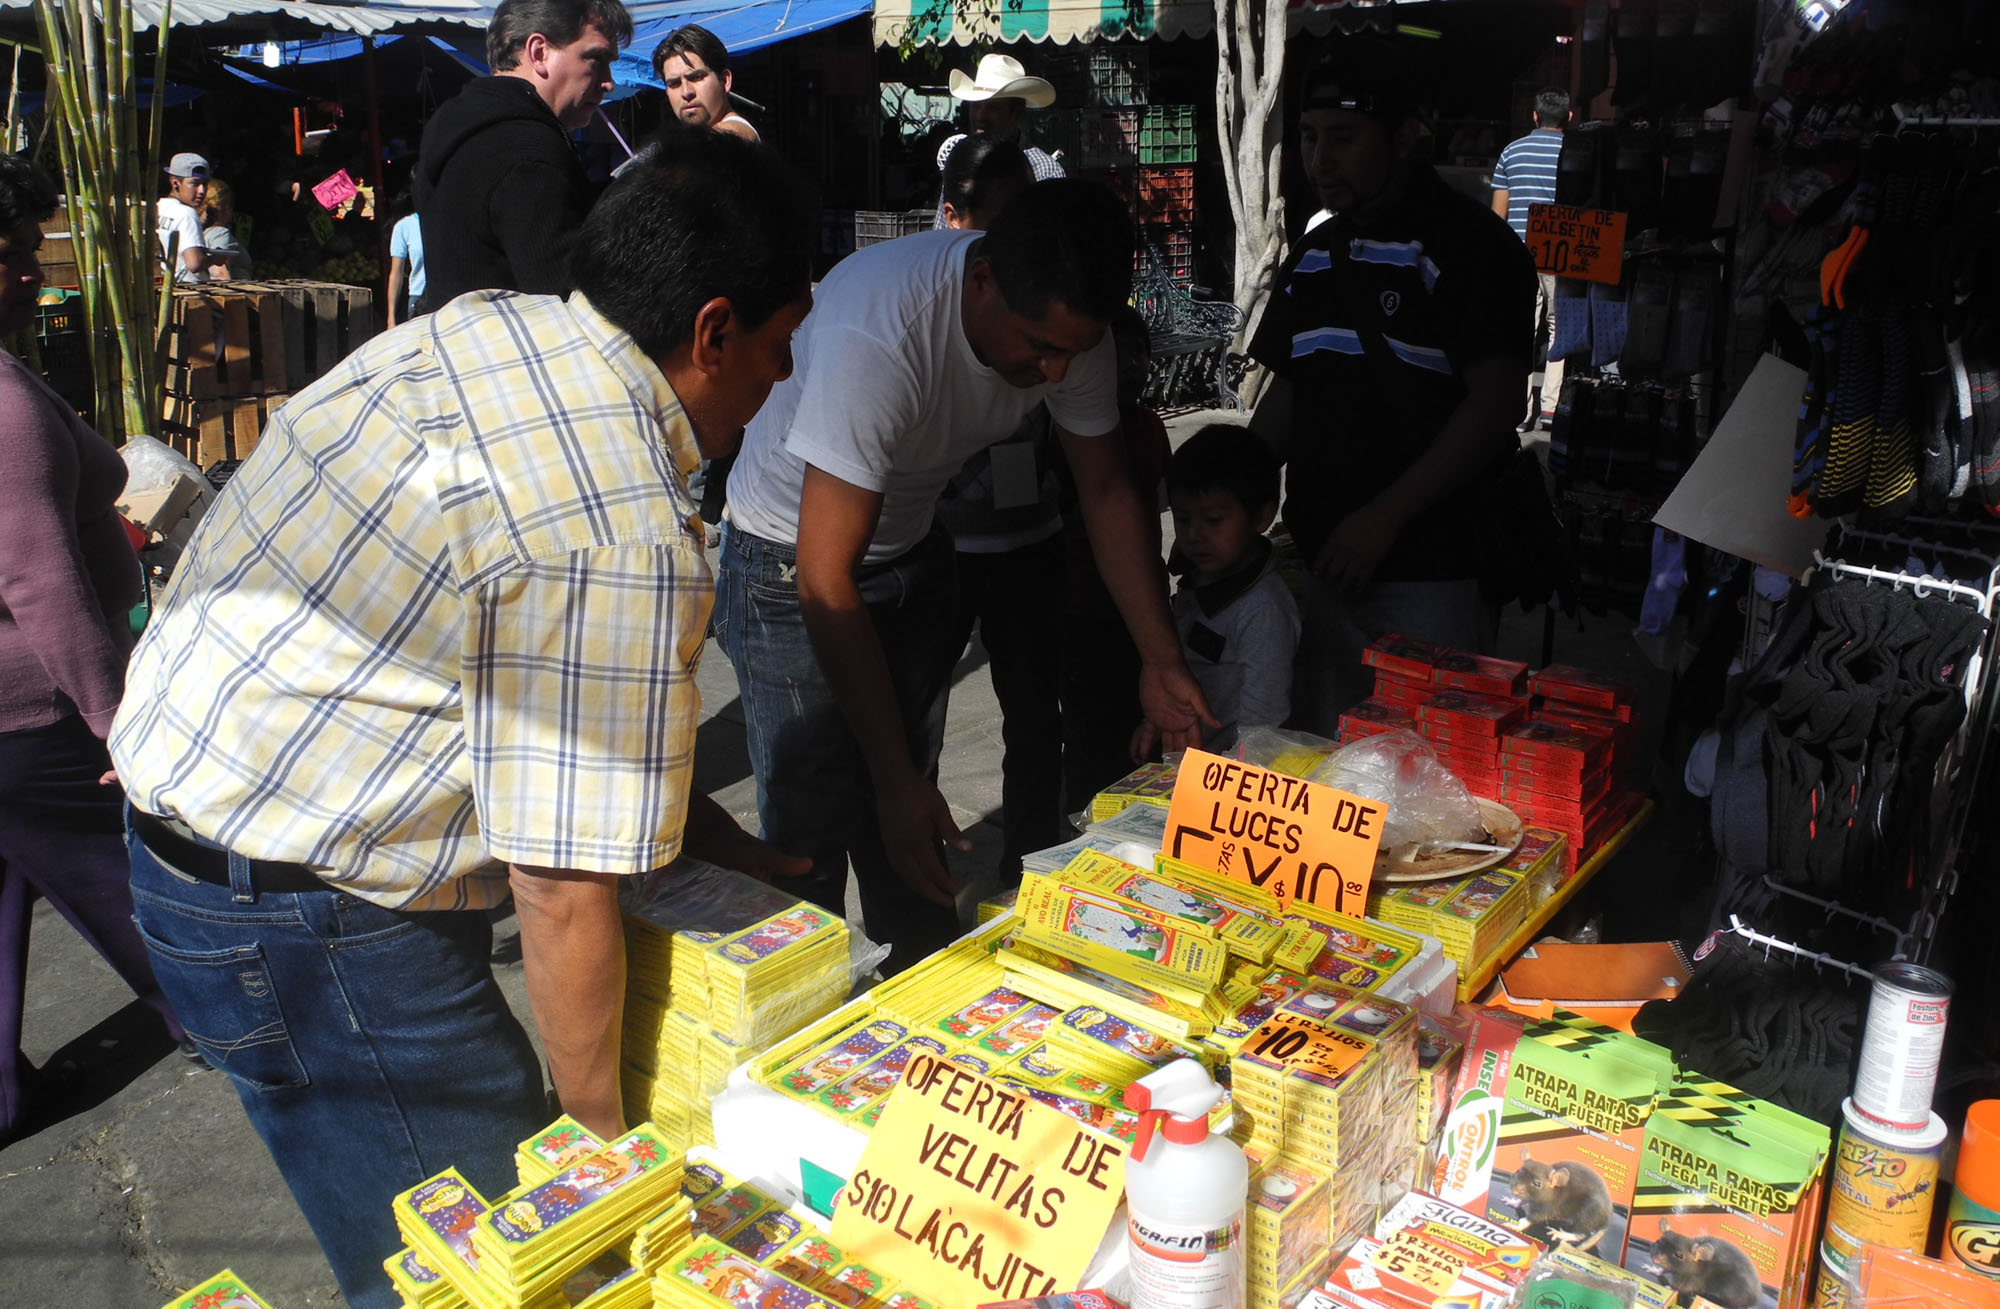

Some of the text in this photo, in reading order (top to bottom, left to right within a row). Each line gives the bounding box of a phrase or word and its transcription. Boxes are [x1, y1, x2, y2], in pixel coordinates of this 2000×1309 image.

[1529, 203, 1615, 226] OFERTA DE
[1532, 219, 1600, 240] CALSETIN
[1203, 762, 1377, 840] OFERTA DE
[1210, 801, 1303, 854] LUCES
[1193, 948, 1204, 971] CORONA
[1252, 1026, 1309, 1059] $10
[1273, 1012, 1367, 1050] CERILLOS
[1308, 1050, 1329, 1061] EL
[1513, 1063, 1578, 1102] ATRAPA
[1583, 1088, 1640, 1125] RATAS
[1524, 1085, 1561, 1112] PEGA
[1567, 1102, 1623, 1136] FUERTE
[906, 1054, 1121, 1191] OFERTA DE
[918, 1123, 1066, 1228] VELITAS
[1647, 1136, 1718, 1180] ATRAPA
[1726, 1169, 1789, 1211] RATAS
[1660, 1159, 1700, 1188] PEGA
[1708, 1181, 1770, 1218] FUERTE
[847, 1169, 897, 1224] $10
[1421, 1201, 1512, 1246] Flama
[1429, 1226, 1486, 1253] mexicana
[1378, 1250, 1411, 1273] $5
[1394, 1245, 1454, 1275] MADERA
